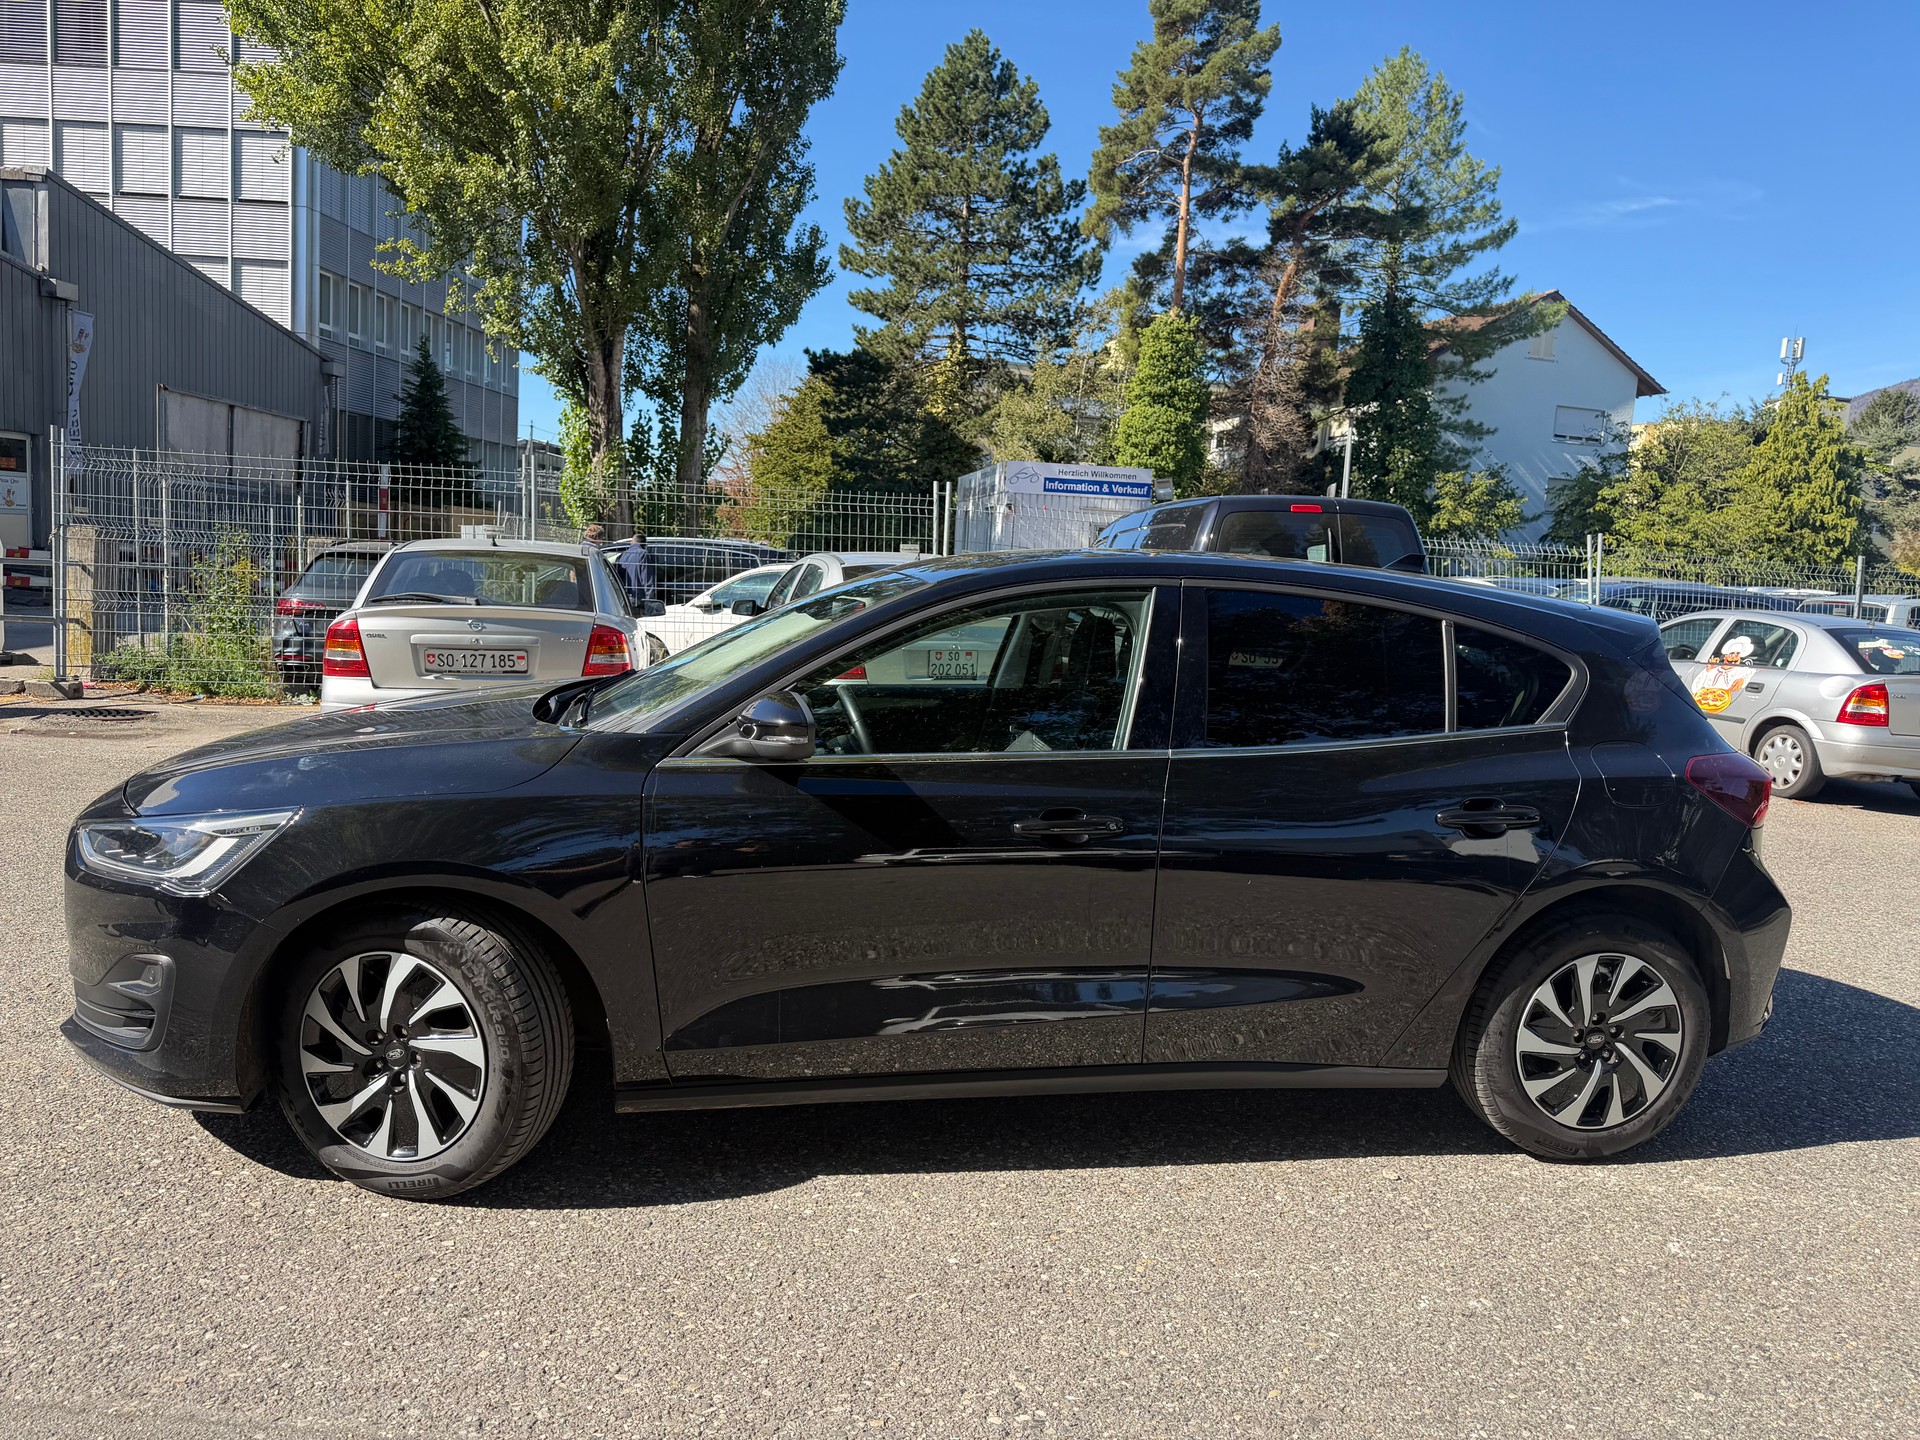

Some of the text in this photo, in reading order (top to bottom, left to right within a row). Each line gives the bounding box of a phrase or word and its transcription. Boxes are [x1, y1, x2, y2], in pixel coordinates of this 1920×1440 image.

[1058, 468, 1137, 480] Herzlich Willkommen
[1045, 480, 1149, 495] Information & Verkauf
[948, 651, 960, 662] SO
[388, 1177, 441, 1190] PIRELLI
